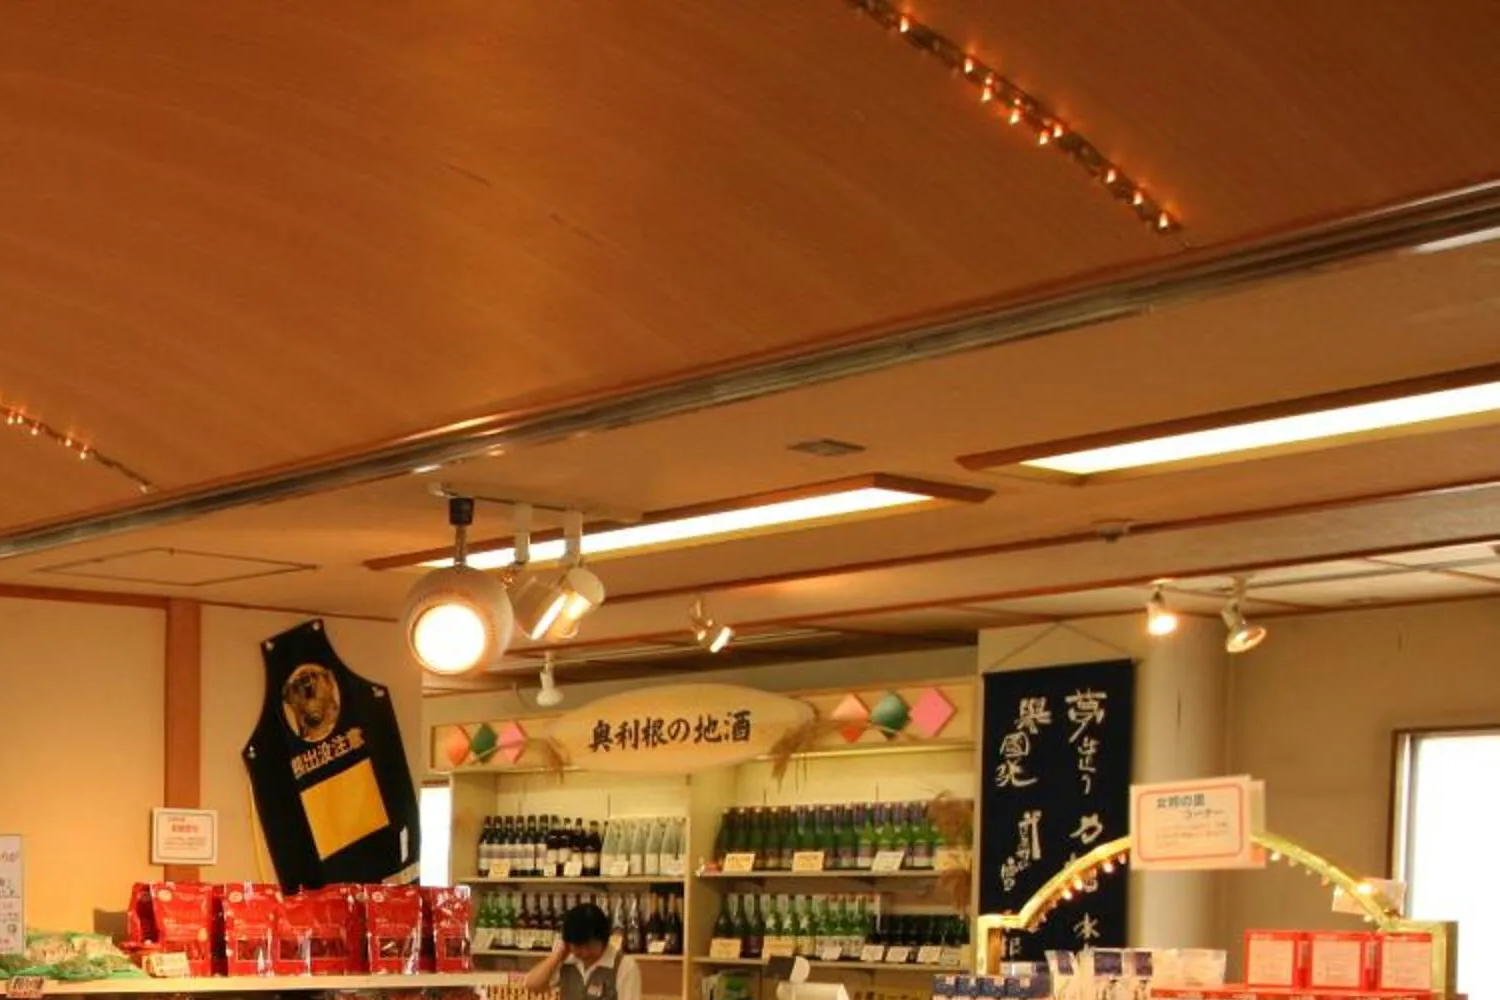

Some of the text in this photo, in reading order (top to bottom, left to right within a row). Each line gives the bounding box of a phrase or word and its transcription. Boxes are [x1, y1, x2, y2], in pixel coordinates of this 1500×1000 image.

[588, 709, 752, 752] 奥利根の地酒
